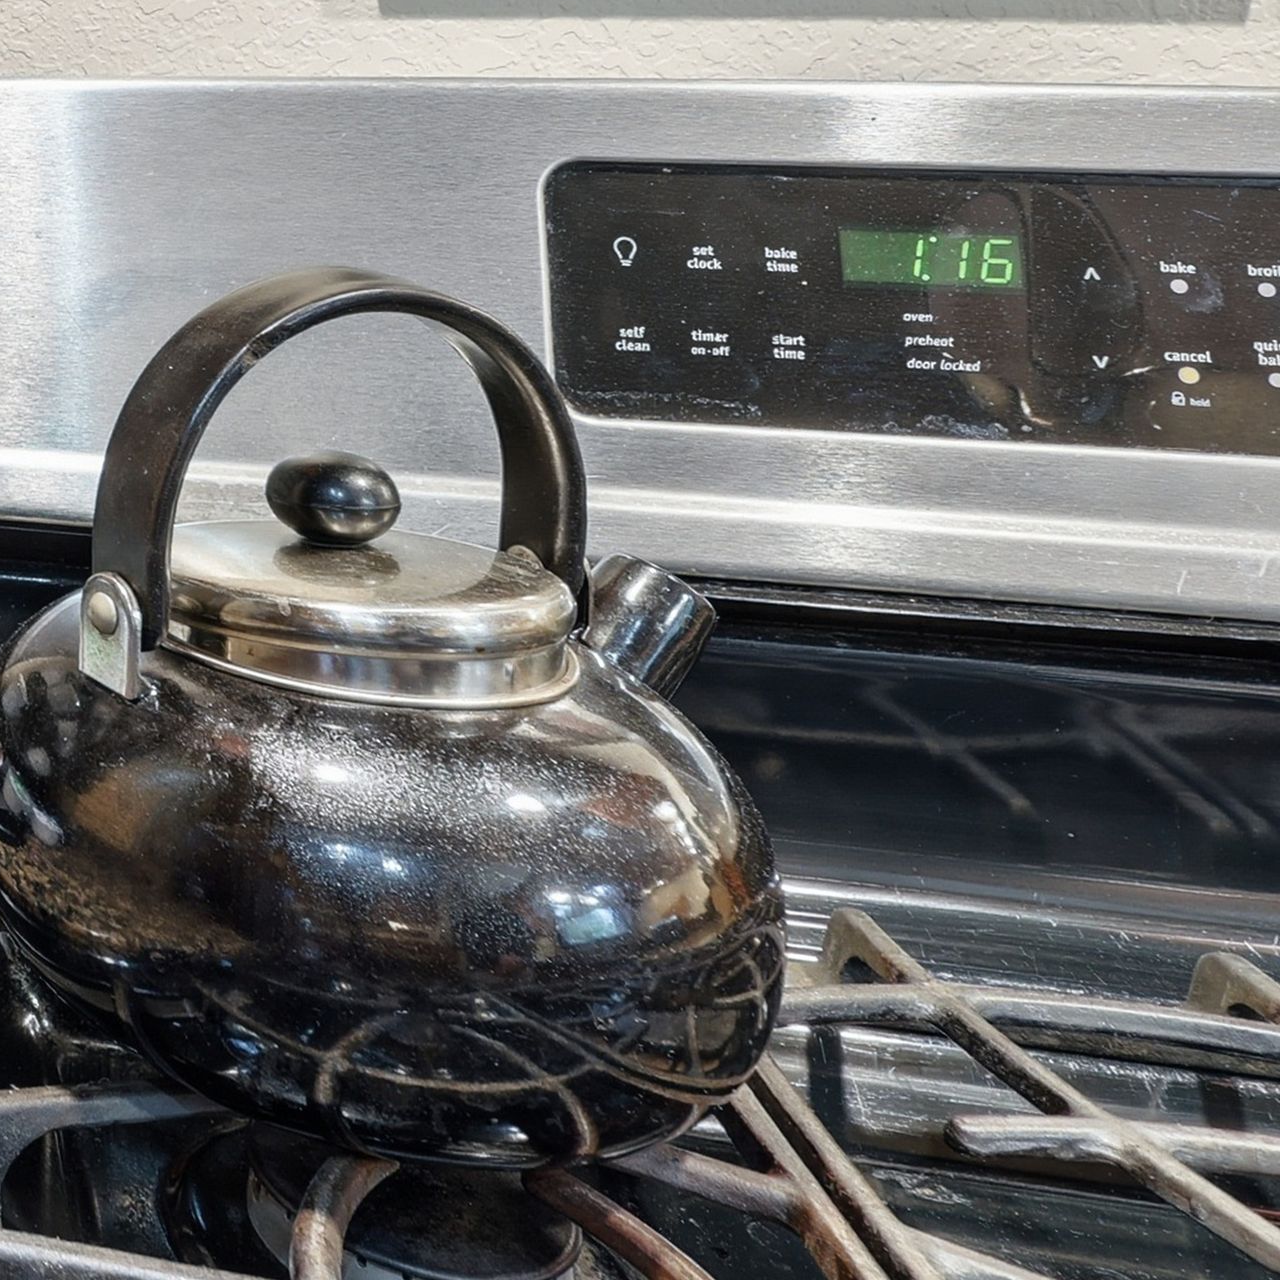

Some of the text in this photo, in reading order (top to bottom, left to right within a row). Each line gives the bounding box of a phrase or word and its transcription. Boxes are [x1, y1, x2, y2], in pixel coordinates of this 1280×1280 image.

[692, 245, 715, 256] set
[765, 247, 798, 260] bake
[687, 257, 722, 270] clock
[766, 260, 799, 273] time
[1159, 261, 1197, 274] bake
[903, 313, 933, 322] oven
[619, 326, 646, 339] self
[691, 330, 729, 343] timer
[615, 339, 651, 352] clean
[772, 334, 806, 347] start
[904, 334, 955, 348] preheat
[773, 347, 806, 360] time
[1163, 351, 1213, 363] cancel
[906, 357, 981, 372] door locked
